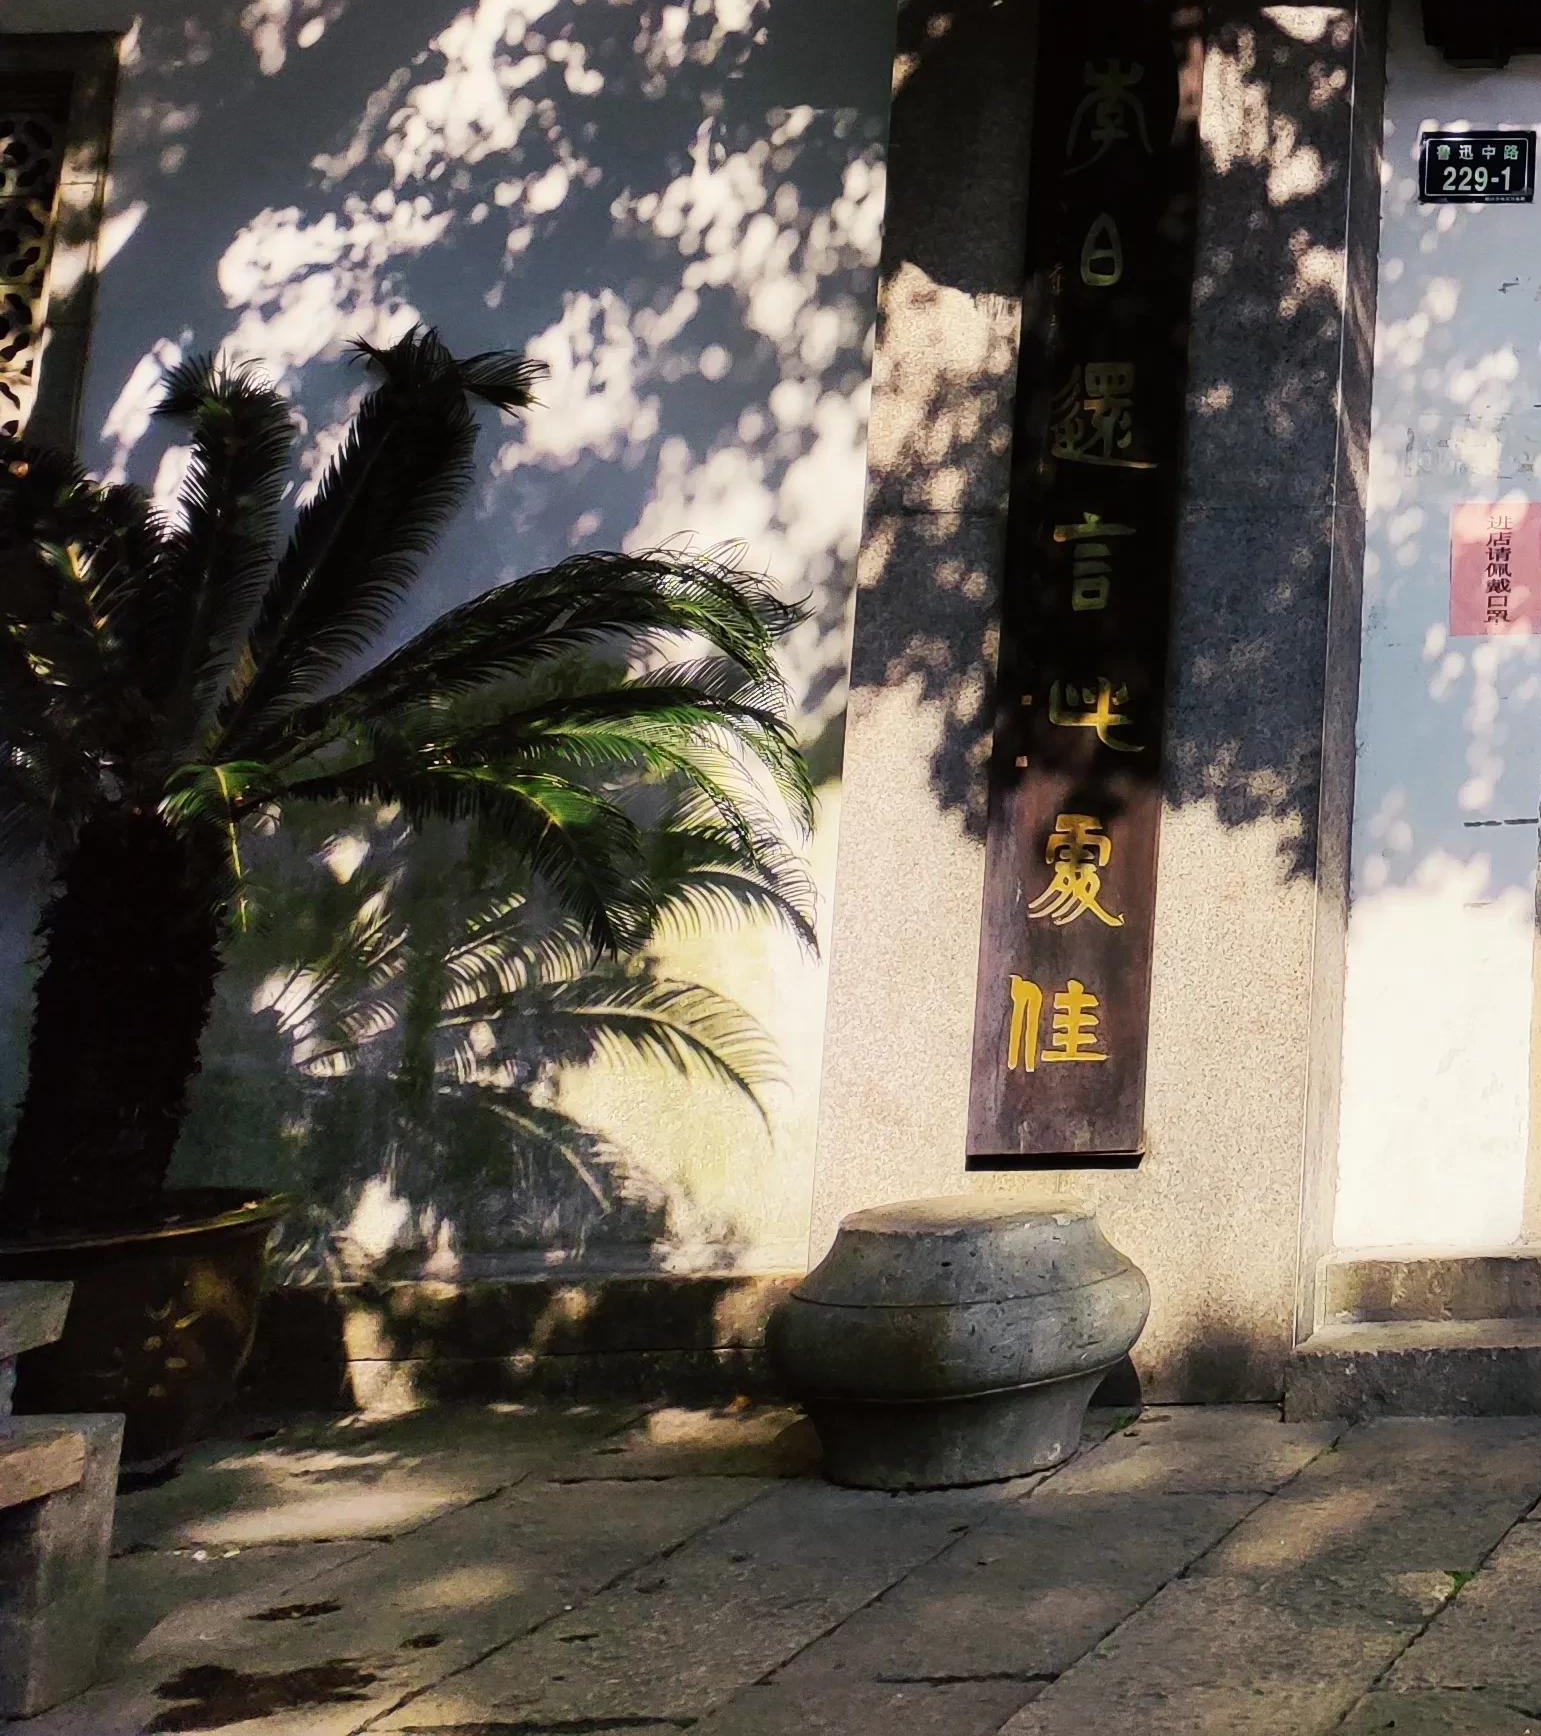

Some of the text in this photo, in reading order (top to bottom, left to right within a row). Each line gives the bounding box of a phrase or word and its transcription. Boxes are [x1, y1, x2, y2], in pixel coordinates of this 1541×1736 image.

[1442, 166, 1511, 192] 229-1
[1483, 514, 1513, 626] 进店请佩戴口罩
